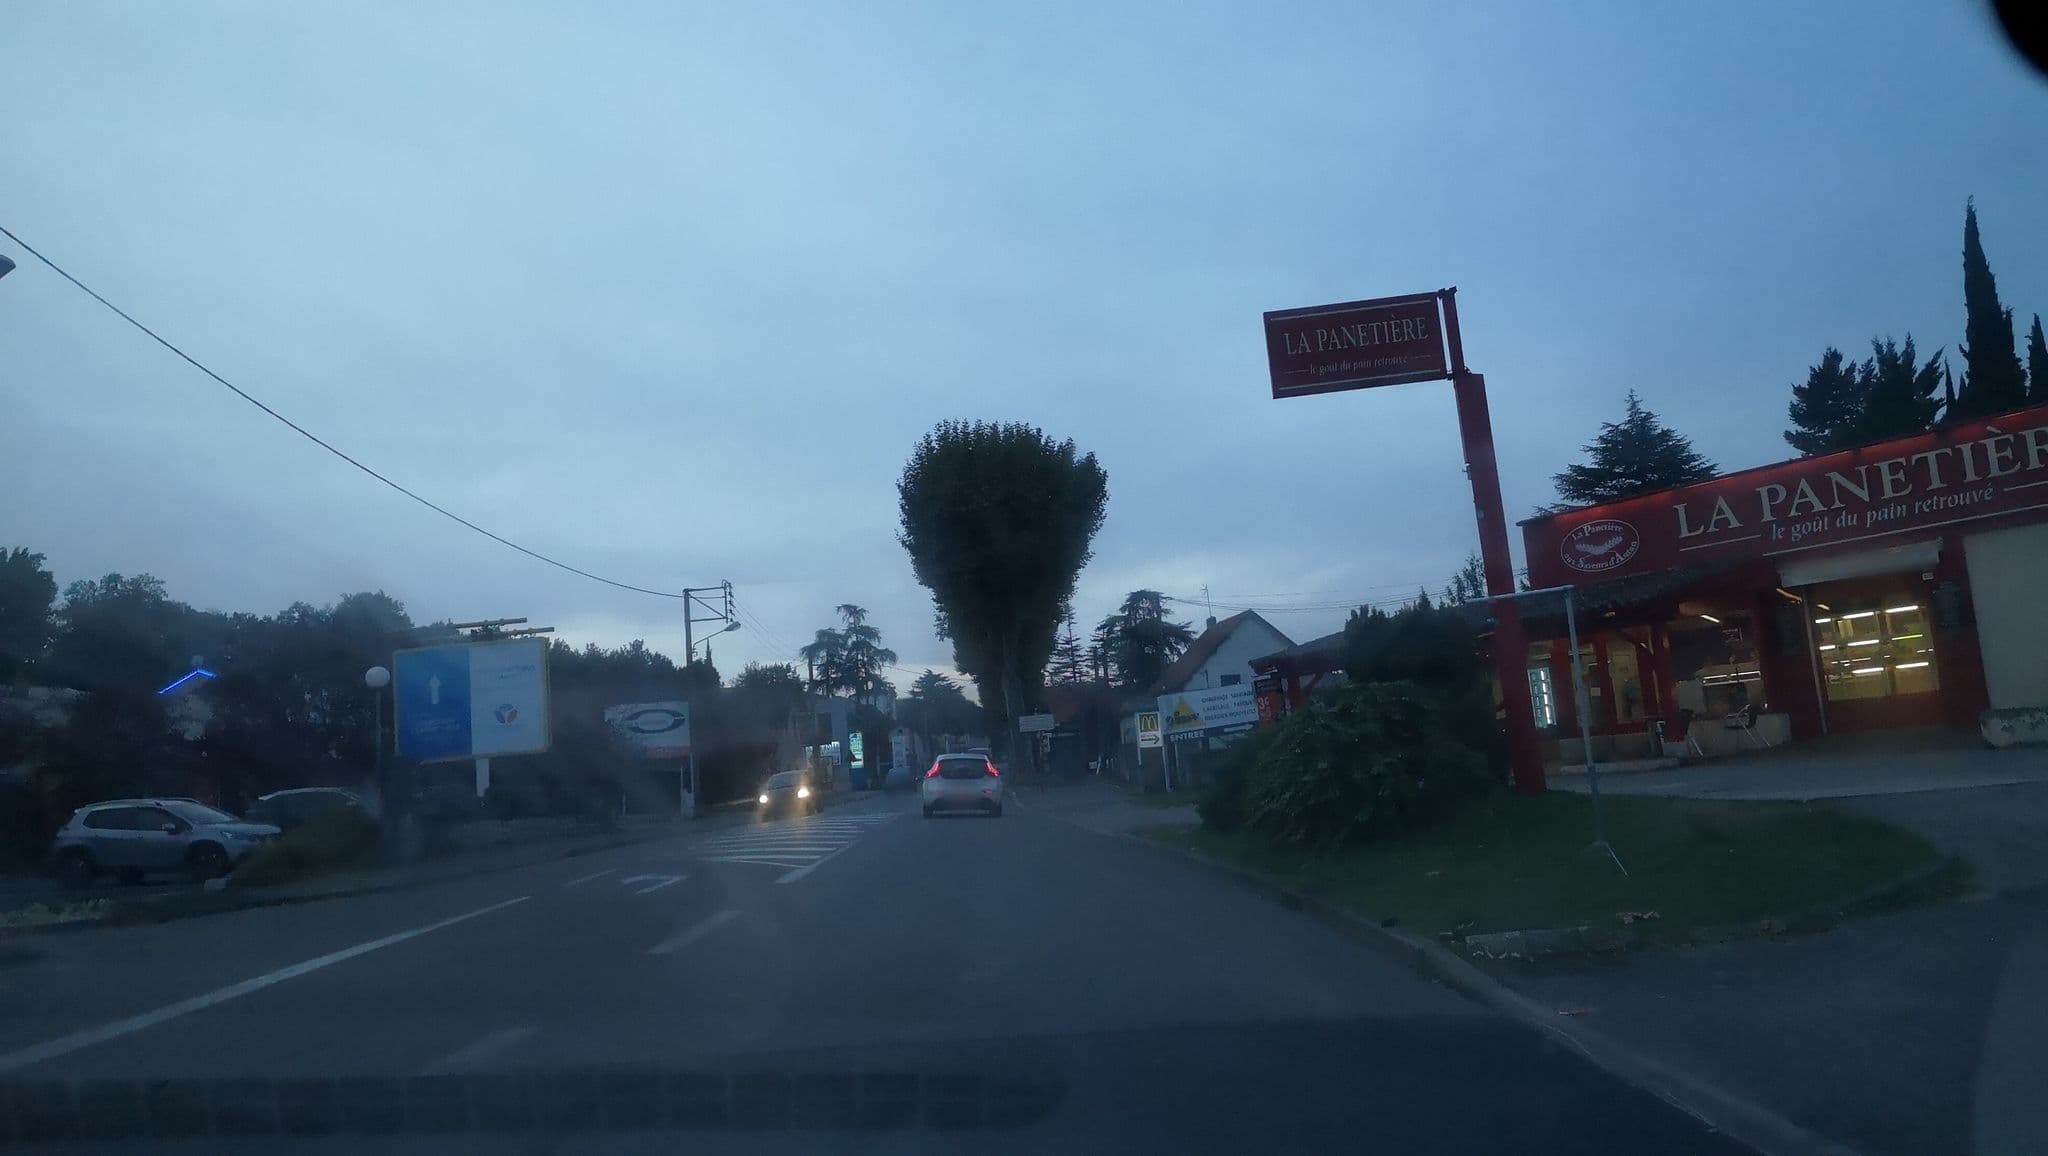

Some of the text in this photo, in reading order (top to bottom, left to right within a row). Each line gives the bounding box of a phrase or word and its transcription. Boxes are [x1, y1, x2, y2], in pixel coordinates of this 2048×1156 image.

[1283, 314, 1428, 354] LA PANETIÈRE
[1310, 362, 1316, 374] le
[1673, 496, 1744, 539] LA
[1772, 483, 1995, 542] le goût du pain retrouvé
